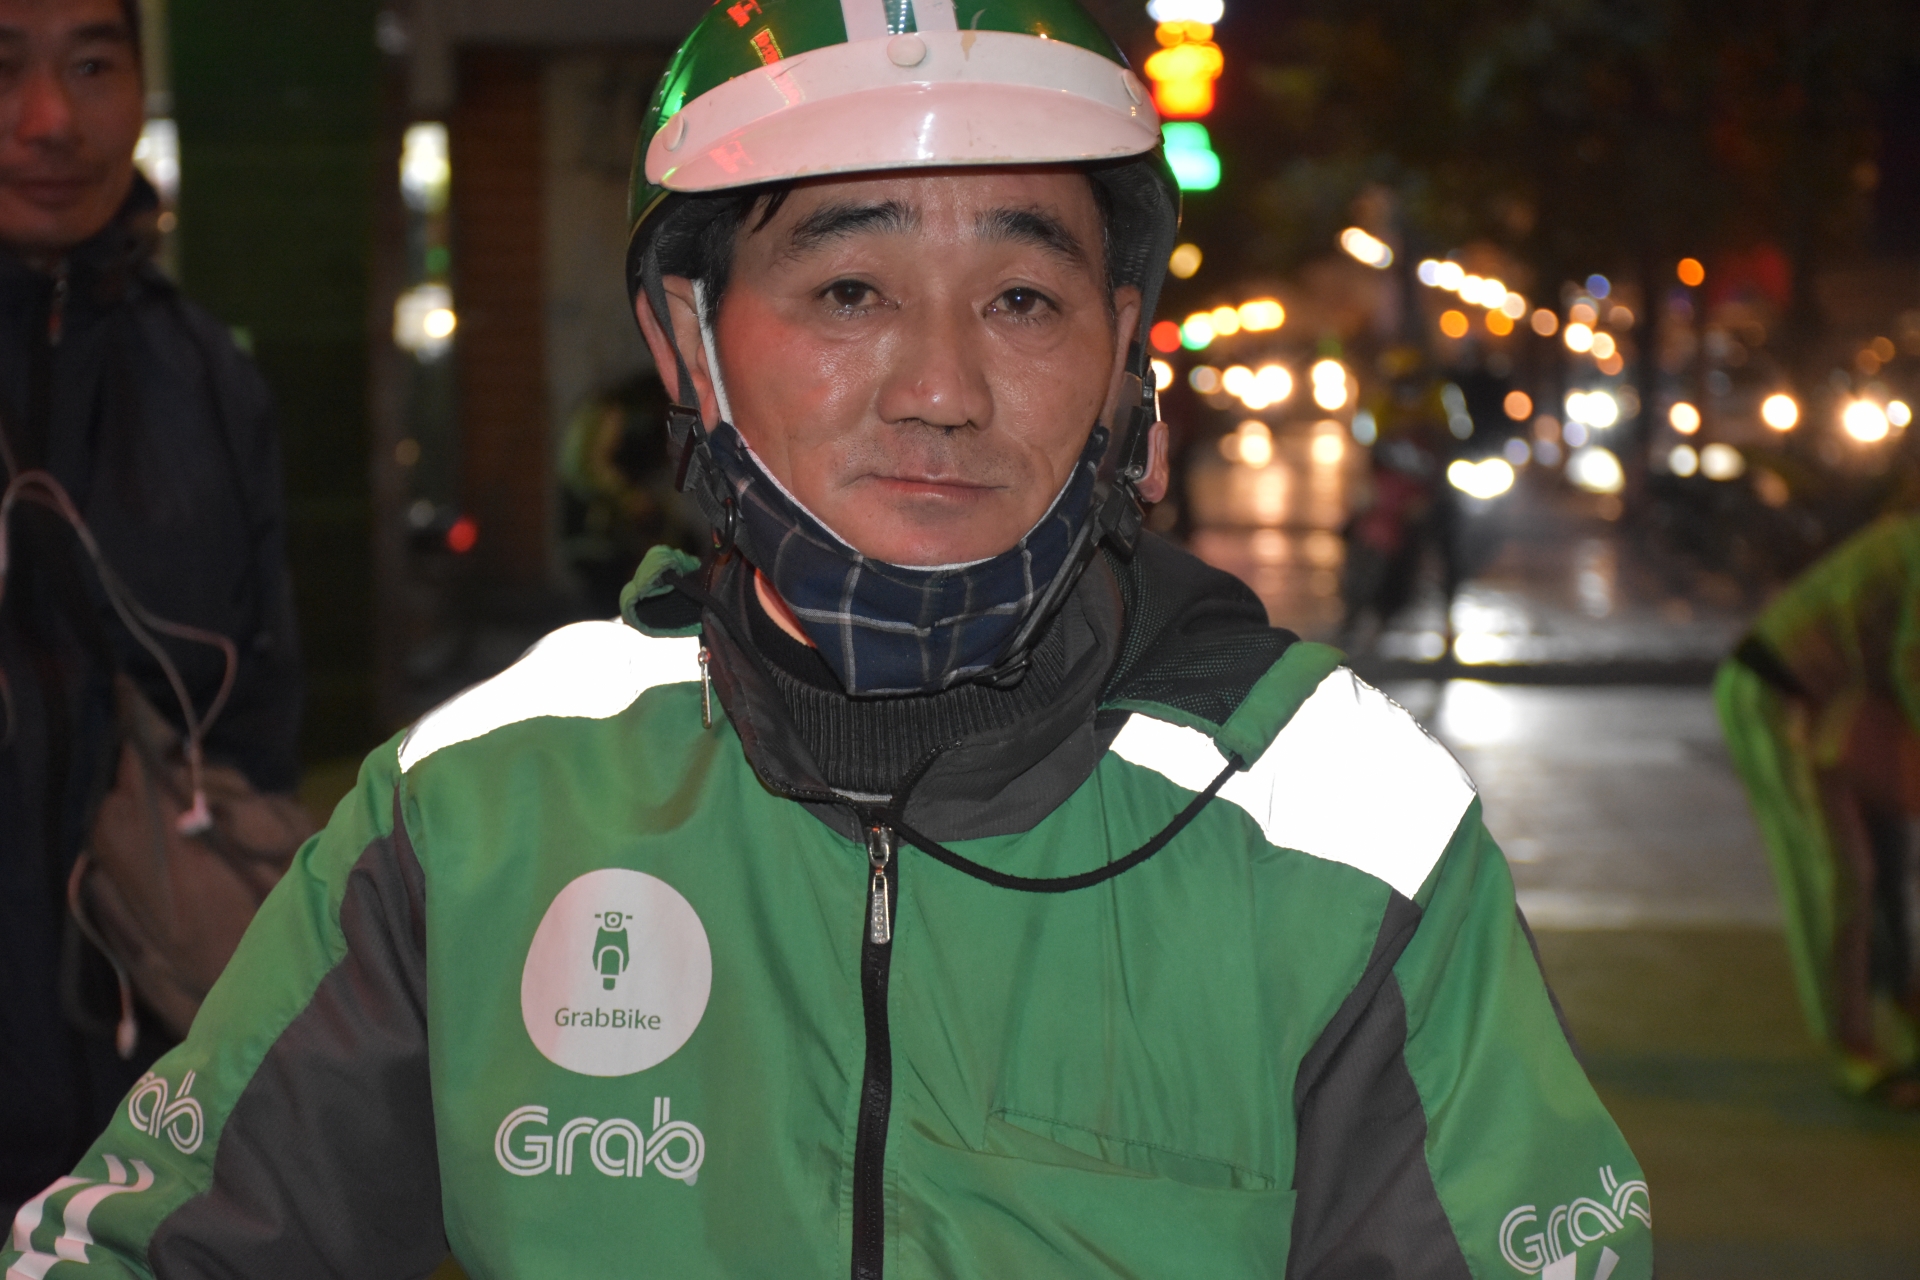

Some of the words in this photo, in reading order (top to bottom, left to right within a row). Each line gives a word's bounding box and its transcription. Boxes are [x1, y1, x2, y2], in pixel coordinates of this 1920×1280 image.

[554, 1007, 661, 1030] GrabBike
[128, 1069, 203, 1155] ab
[494, 1097, 705, 1179] Grab
[1499, 1165, 1652, 1275] Grab
